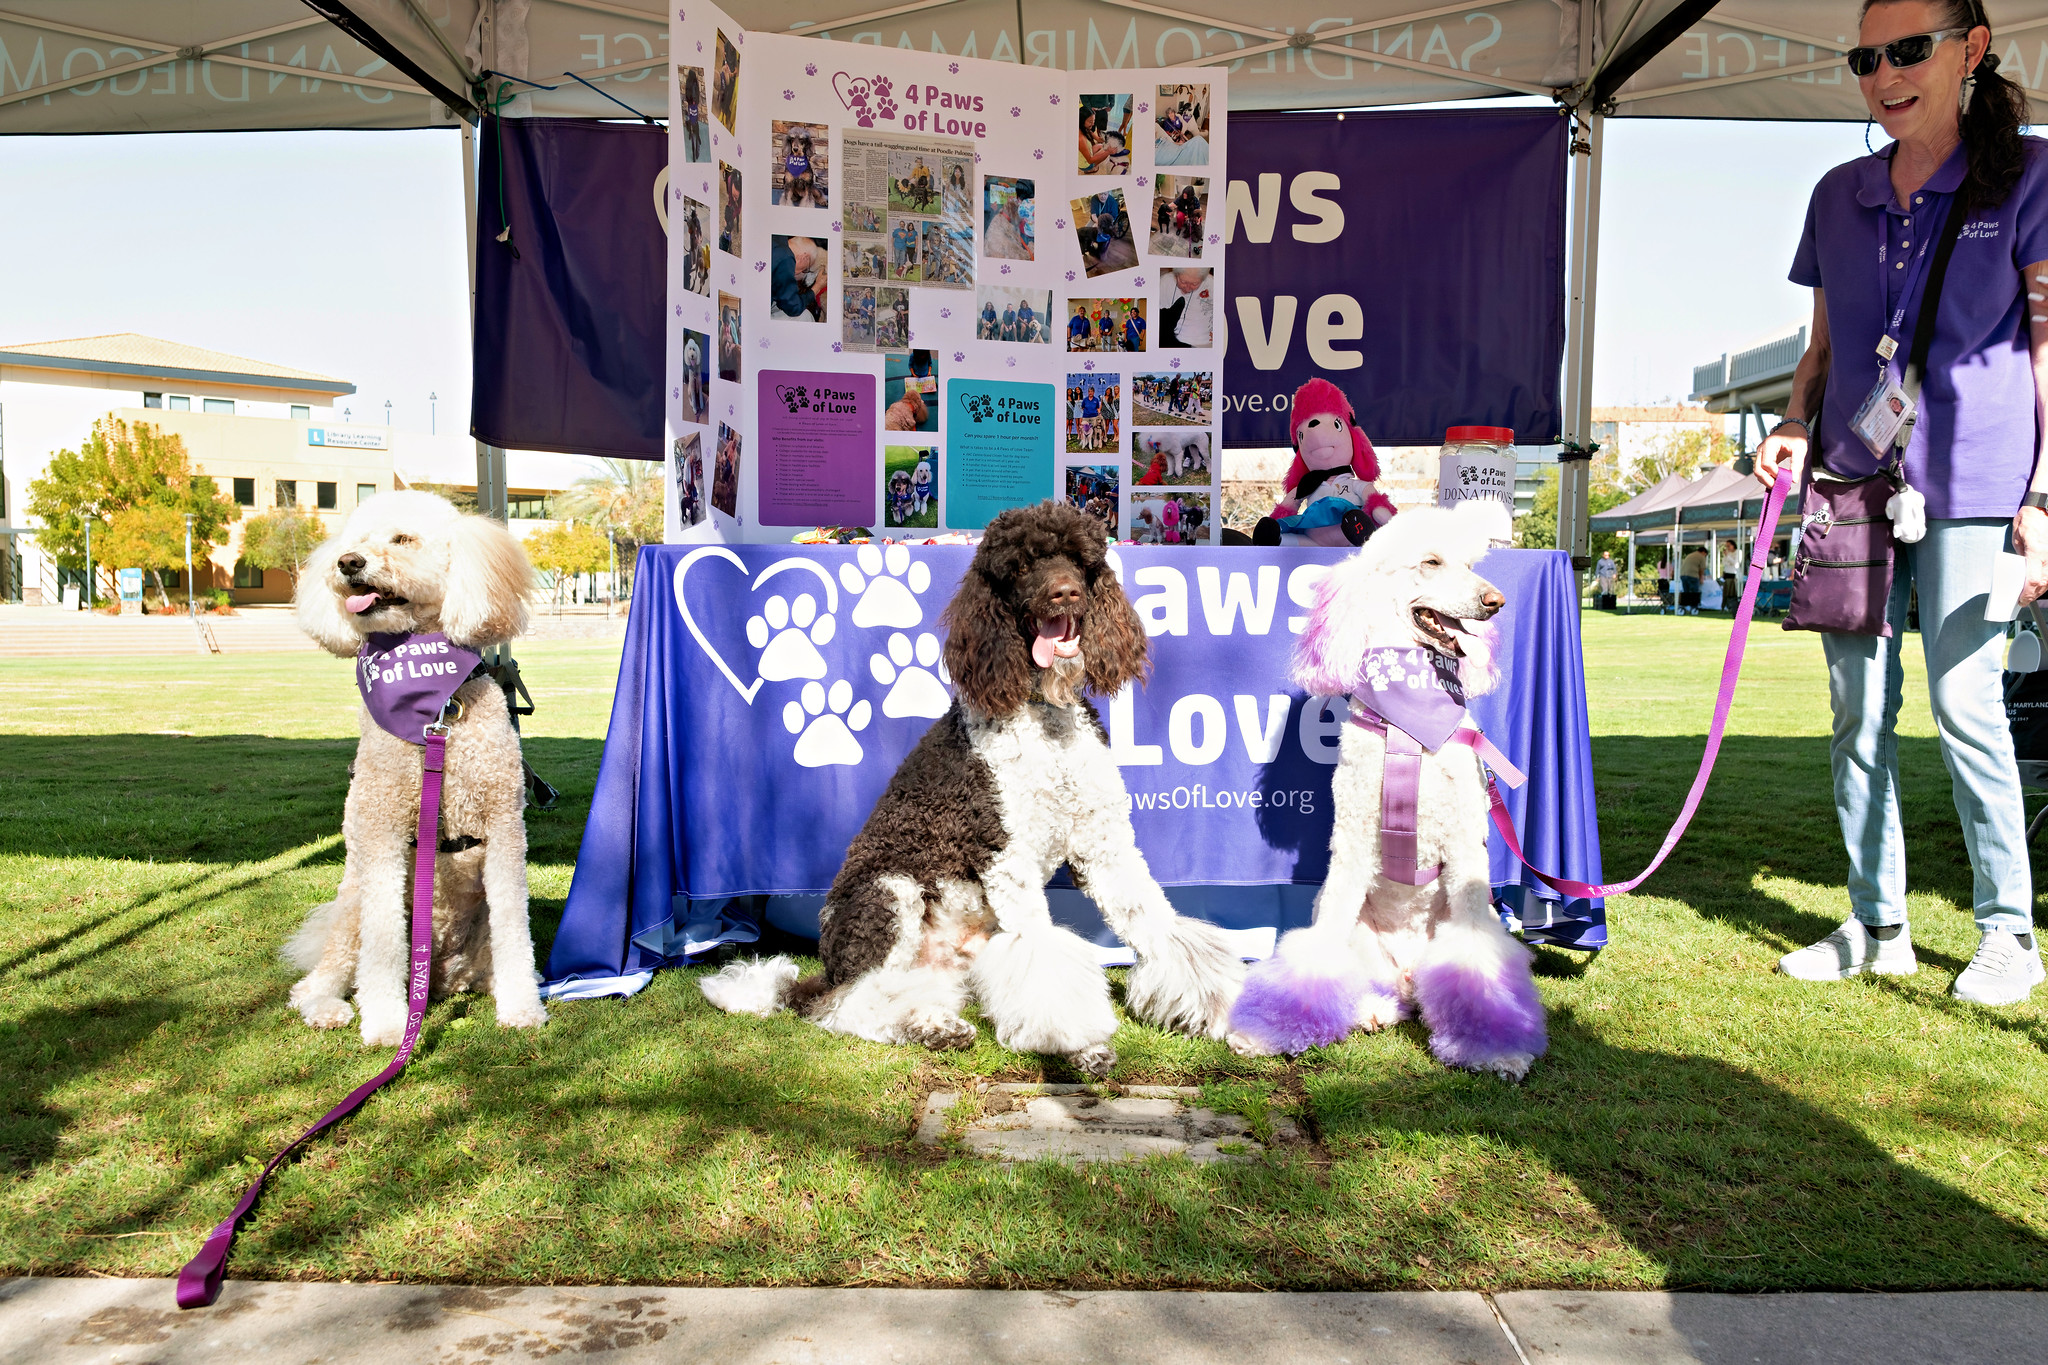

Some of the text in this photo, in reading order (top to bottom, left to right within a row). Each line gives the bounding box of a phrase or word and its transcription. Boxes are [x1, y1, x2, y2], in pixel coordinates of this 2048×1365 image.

[905, 84, 984, 112] 4 Paws
[904, 110, 986, 138] of Love
[1225, 171, 1345, 244] ws
[1969, 230, 1999, 239] of Love
[1977, 221, 1999, 229] Paws
[1224, 293, 1364, 370] ve
[813, 388, 856, 401] 4 Paws
[997, 397, 1040, 411] 4 Paws
[812, 401, 857, 414] of Love
[996, 411, 1041, 425] of Love
[1480, 477, 1490, 485] of
[1481, 467, 1506, 477] 4 Paws
[1106, 549, 1328, 636] aws
[394, 641, 449, 658] Paws
[382, 661, 458, 684] of Love
[1405, 649, 1458, 676] 4 Paws
[1407, 669, 1464, 696] of Love
[1109, 683, 1350, 766] Love
[1124, 784, 1315, 814] awsOfLove.org
